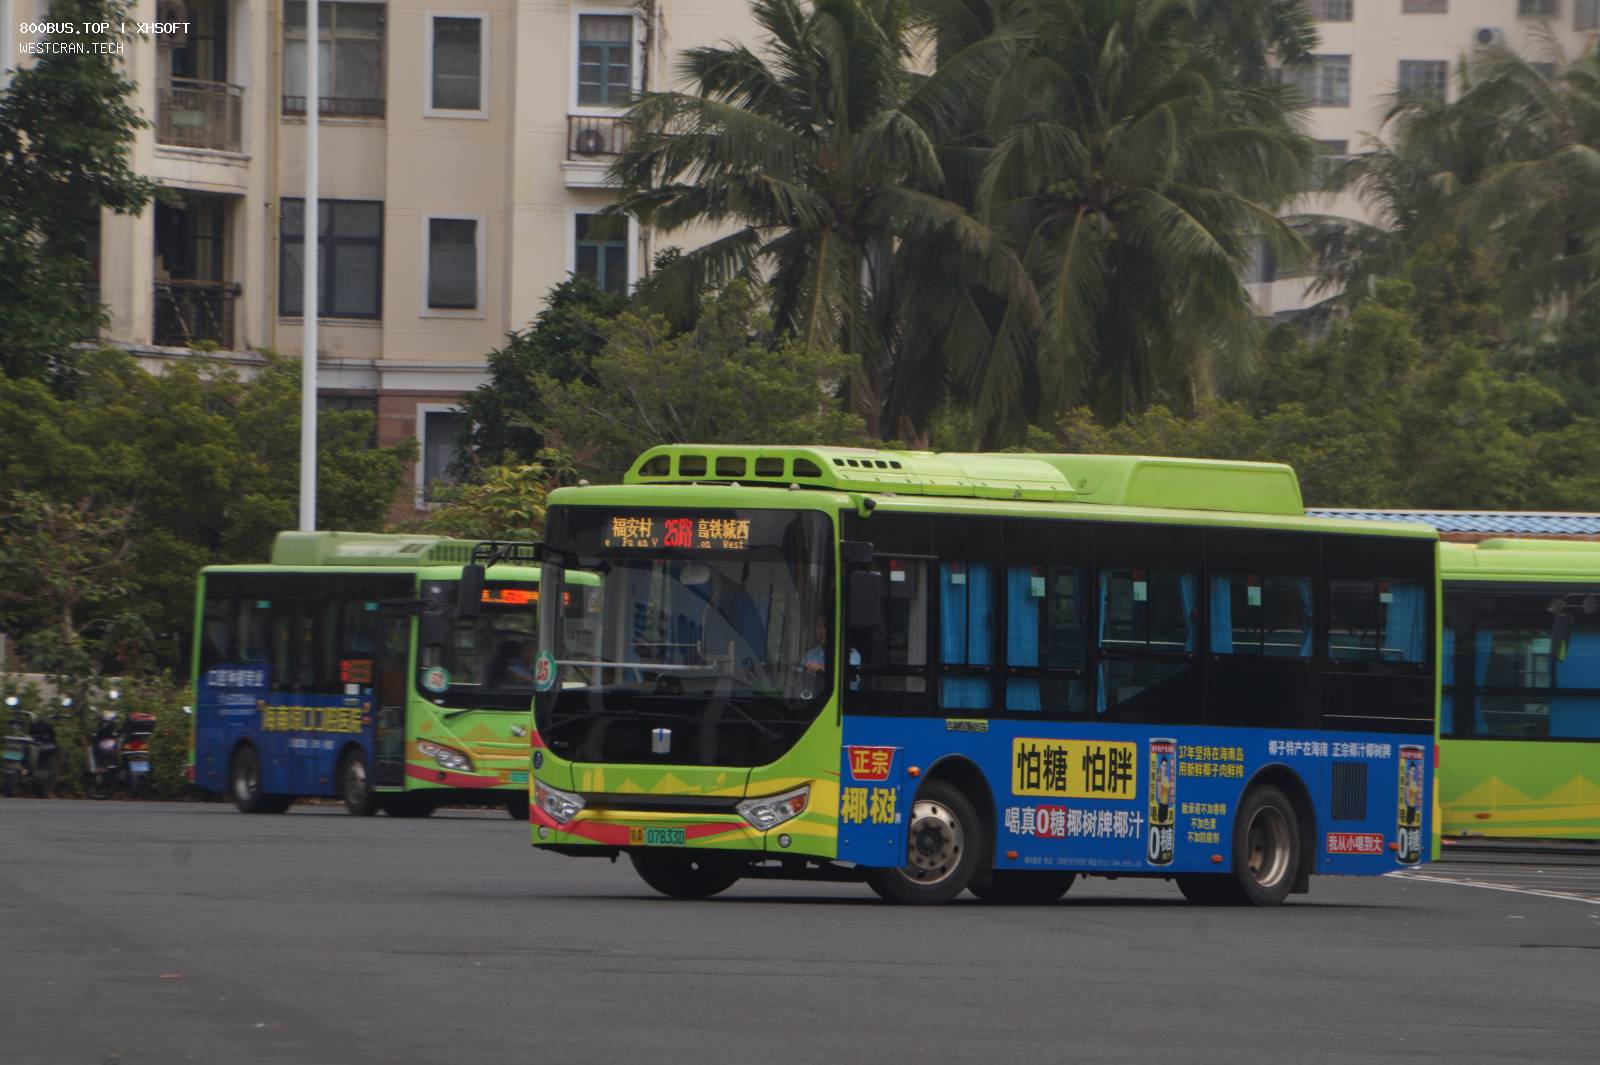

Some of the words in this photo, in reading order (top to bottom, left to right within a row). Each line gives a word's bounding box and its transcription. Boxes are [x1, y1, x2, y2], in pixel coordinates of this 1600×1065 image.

[612, 517, 653, 537] 福安村
[697, 519, 749, 540] 高铁城西
[853, 750, 888, 774] 正宗
[1016, 742, 1068, 792] 怕糖
[1081, 745, 1132, 794] 怕胖
[840, 787, 896, 824] 椰树
[1005, 807, 1143, 839] 喝真0糖椰树牌椰汁
[1329, 835, 1382, 852] 我从小喝到大
